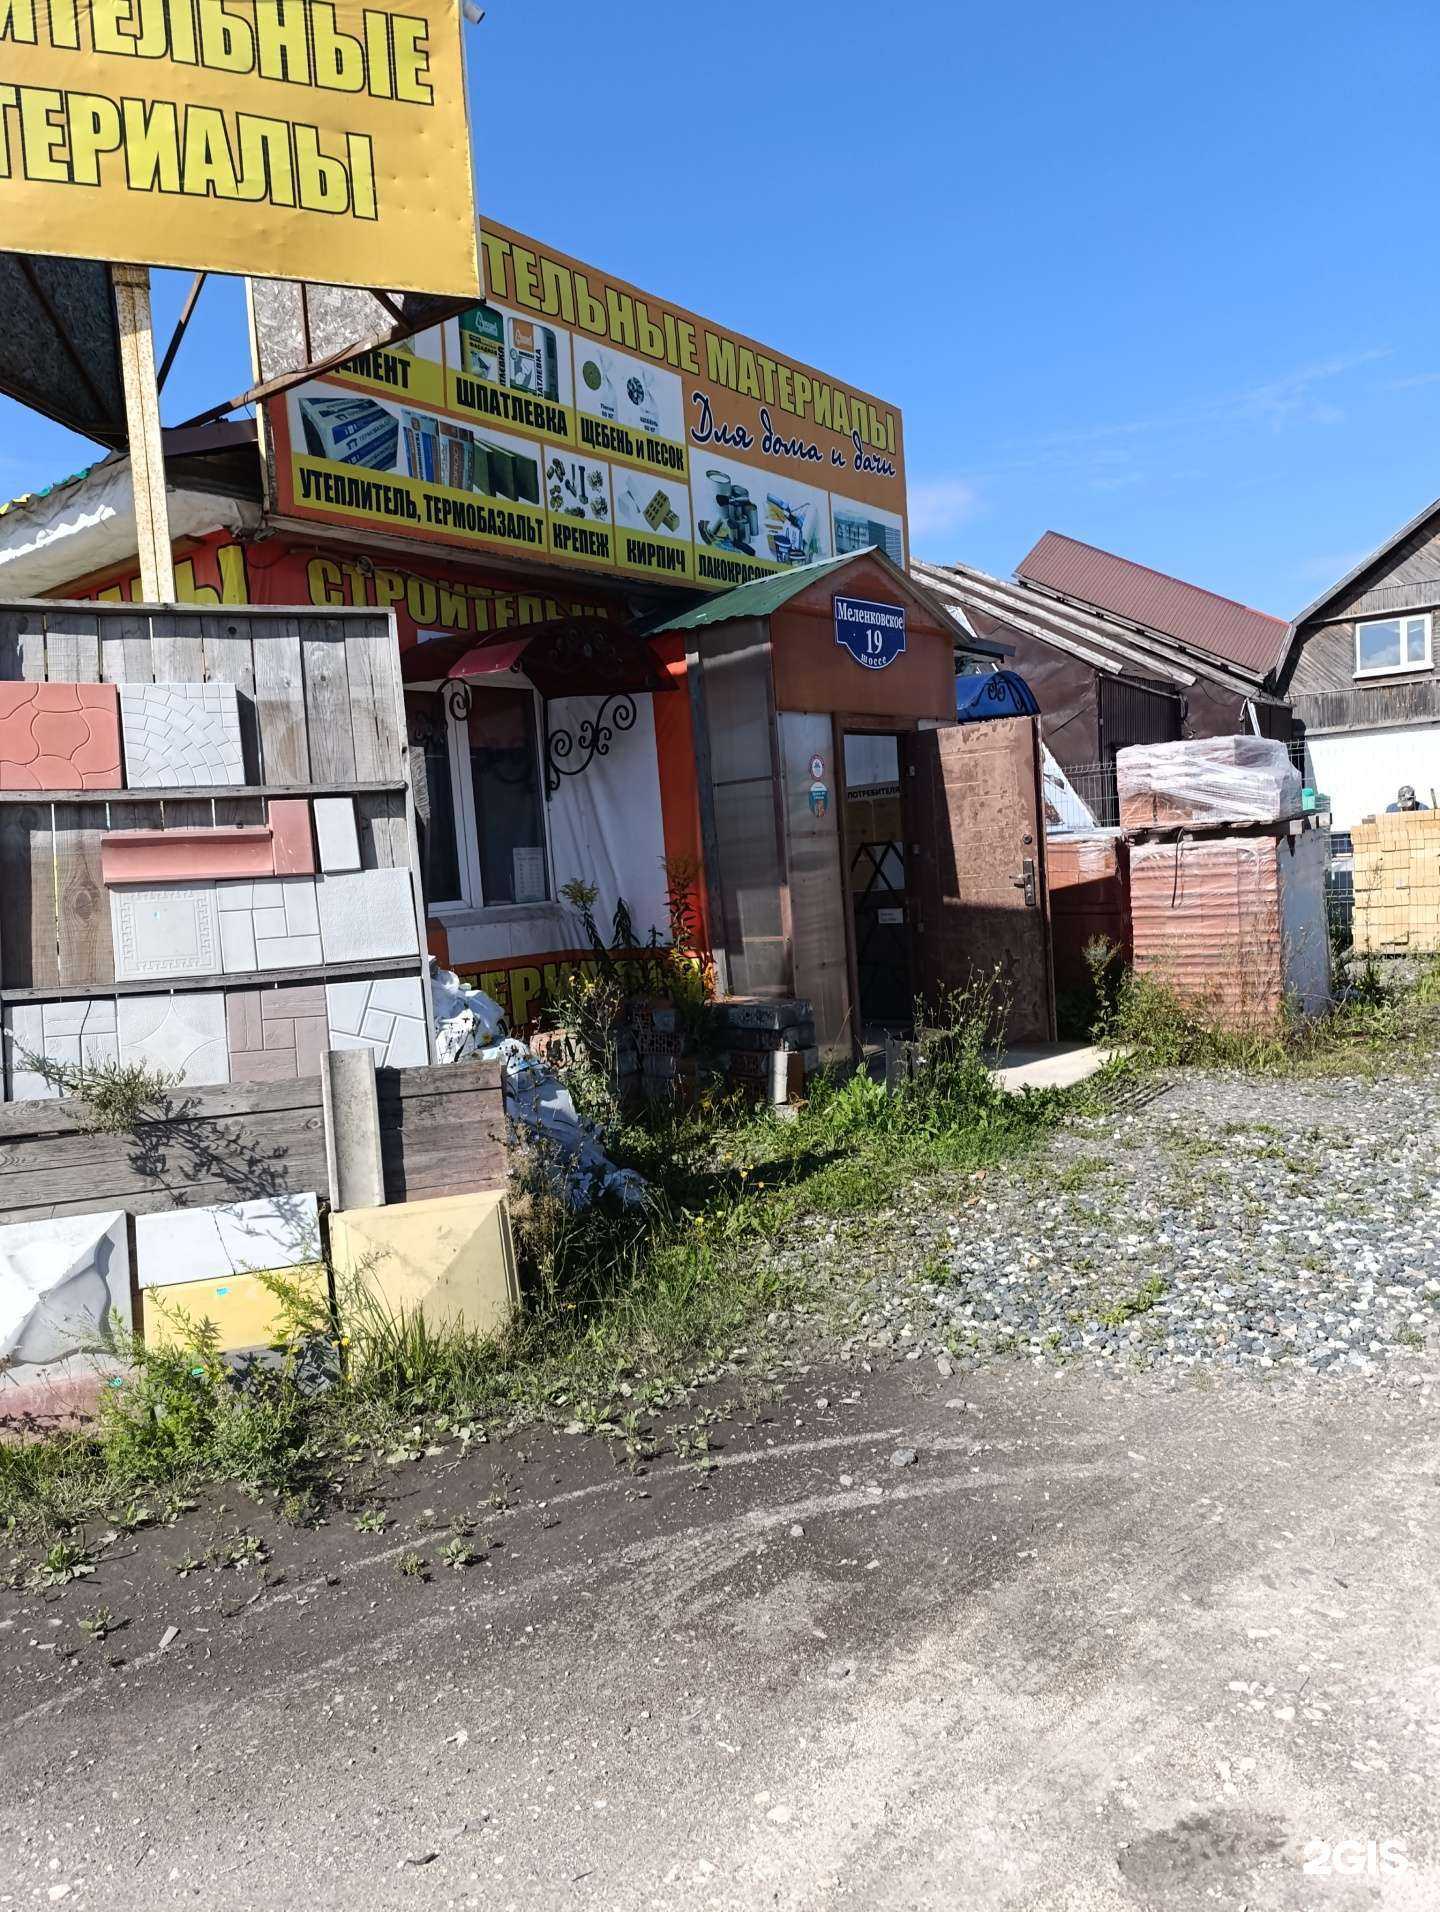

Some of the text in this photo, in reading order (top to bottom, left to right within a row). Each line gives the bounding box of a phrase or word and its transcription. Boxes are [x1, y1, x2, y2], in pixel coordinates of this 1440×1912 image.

[456, 376, 569, 437] ШПАТЛЕВКА
[704, 330, 897, 456] МАТЕРИАЛЫ
[580, 416, 633, 456] ЩЕБЕНЬ
[646, 437, 685, 472] ПЕСОК
[691, 391, 896, 477] Для дома и дачи
[299, 467, 545, 546] УТЕПЛИТЕЛЬ, ТЕРМОБАЗАЛЬТ
[552, 522, 610, 558] КРЕПЕЖ
[626, 538, 686, 573] КИРПИЧ
[837, 601, 903, 630] Меленковское
[860, 653, 887, 666] шоссе
[865, 628, 883, 655] 19
